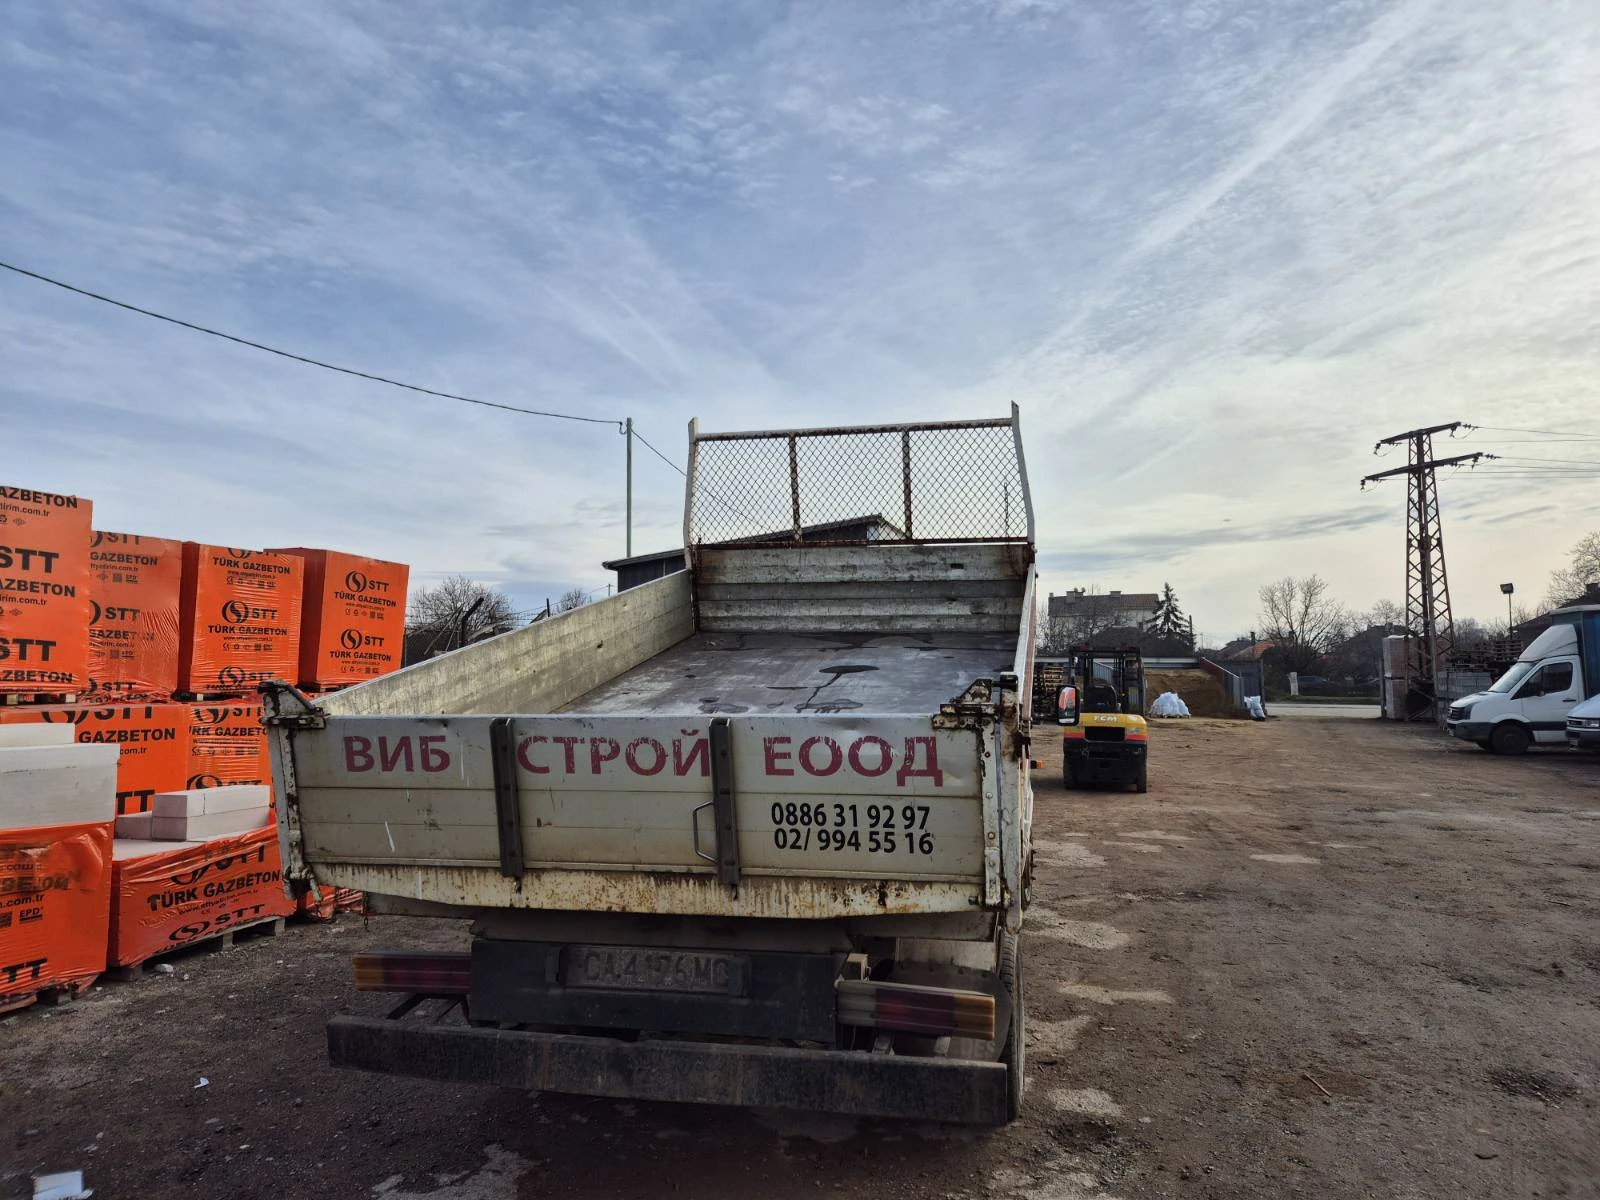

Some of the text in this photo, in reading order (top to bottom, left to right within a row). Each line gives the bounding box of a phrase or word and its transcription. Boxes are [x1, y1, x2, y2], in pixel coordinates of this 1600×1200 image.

[90, 551, 158, 566] GAZBETON
[242, 561, 290, 574] GAZBETON
[368, 580, 389, 592] STT
[358, 594, 397, 607] GAZBETON
[105, 606, 140, 621] STT
[251, 607, 278, 619] STT
[207, 624, 288, 636] TÜRK GAZBETON
[364, 635, 385, 647] STT
[329, 649, 392, 661] TÜRK GAZBETON
[102, 681, 137, 692] STT
[78, 727, 176, 744] GAZBETON
[343, 728, 944, 788] ВИБ СТРОЙ ЕООД
[771, 802, 931, 830] 0886 31 92 97
[817, 829, 861, 852] 994
[868, 831, 896, 854] 55
[904, 832, 934, 855] 16
[147, 870, 280, 912] TÜRK GAZBETON
[215, 903, 265, 925] STT
